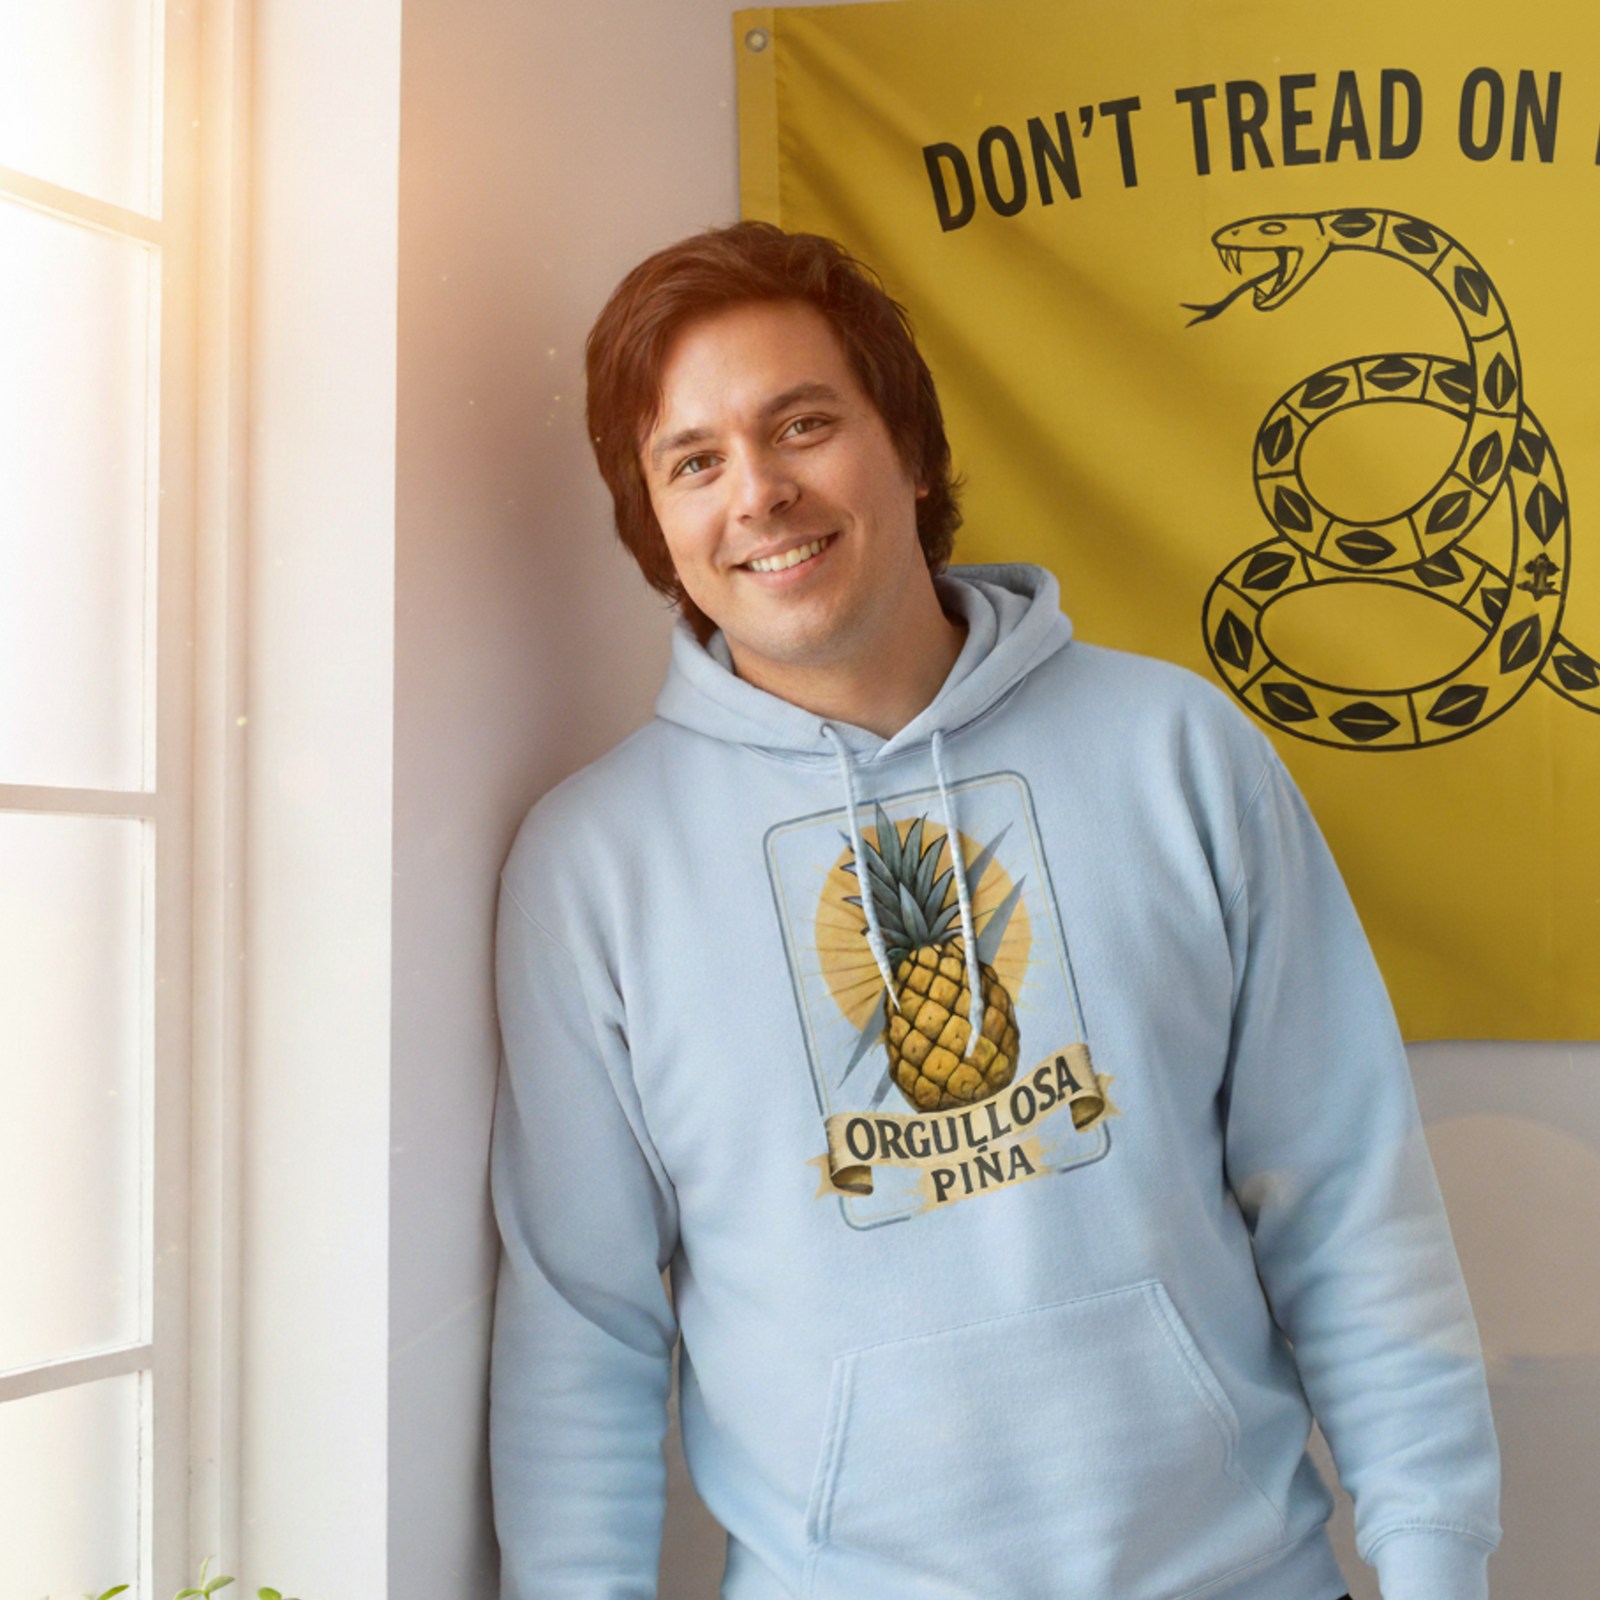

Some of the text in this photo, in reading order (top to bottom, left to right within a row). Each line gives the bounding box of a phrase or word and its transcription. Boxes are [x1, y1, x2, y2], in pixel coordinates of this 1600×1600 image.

[922, 66, 1562, 233] DON'T TREAD ON
[845, 1055, 1083, 1161] ORGULLOSA
[930, 1144, 1036, 1203] PIÑA
